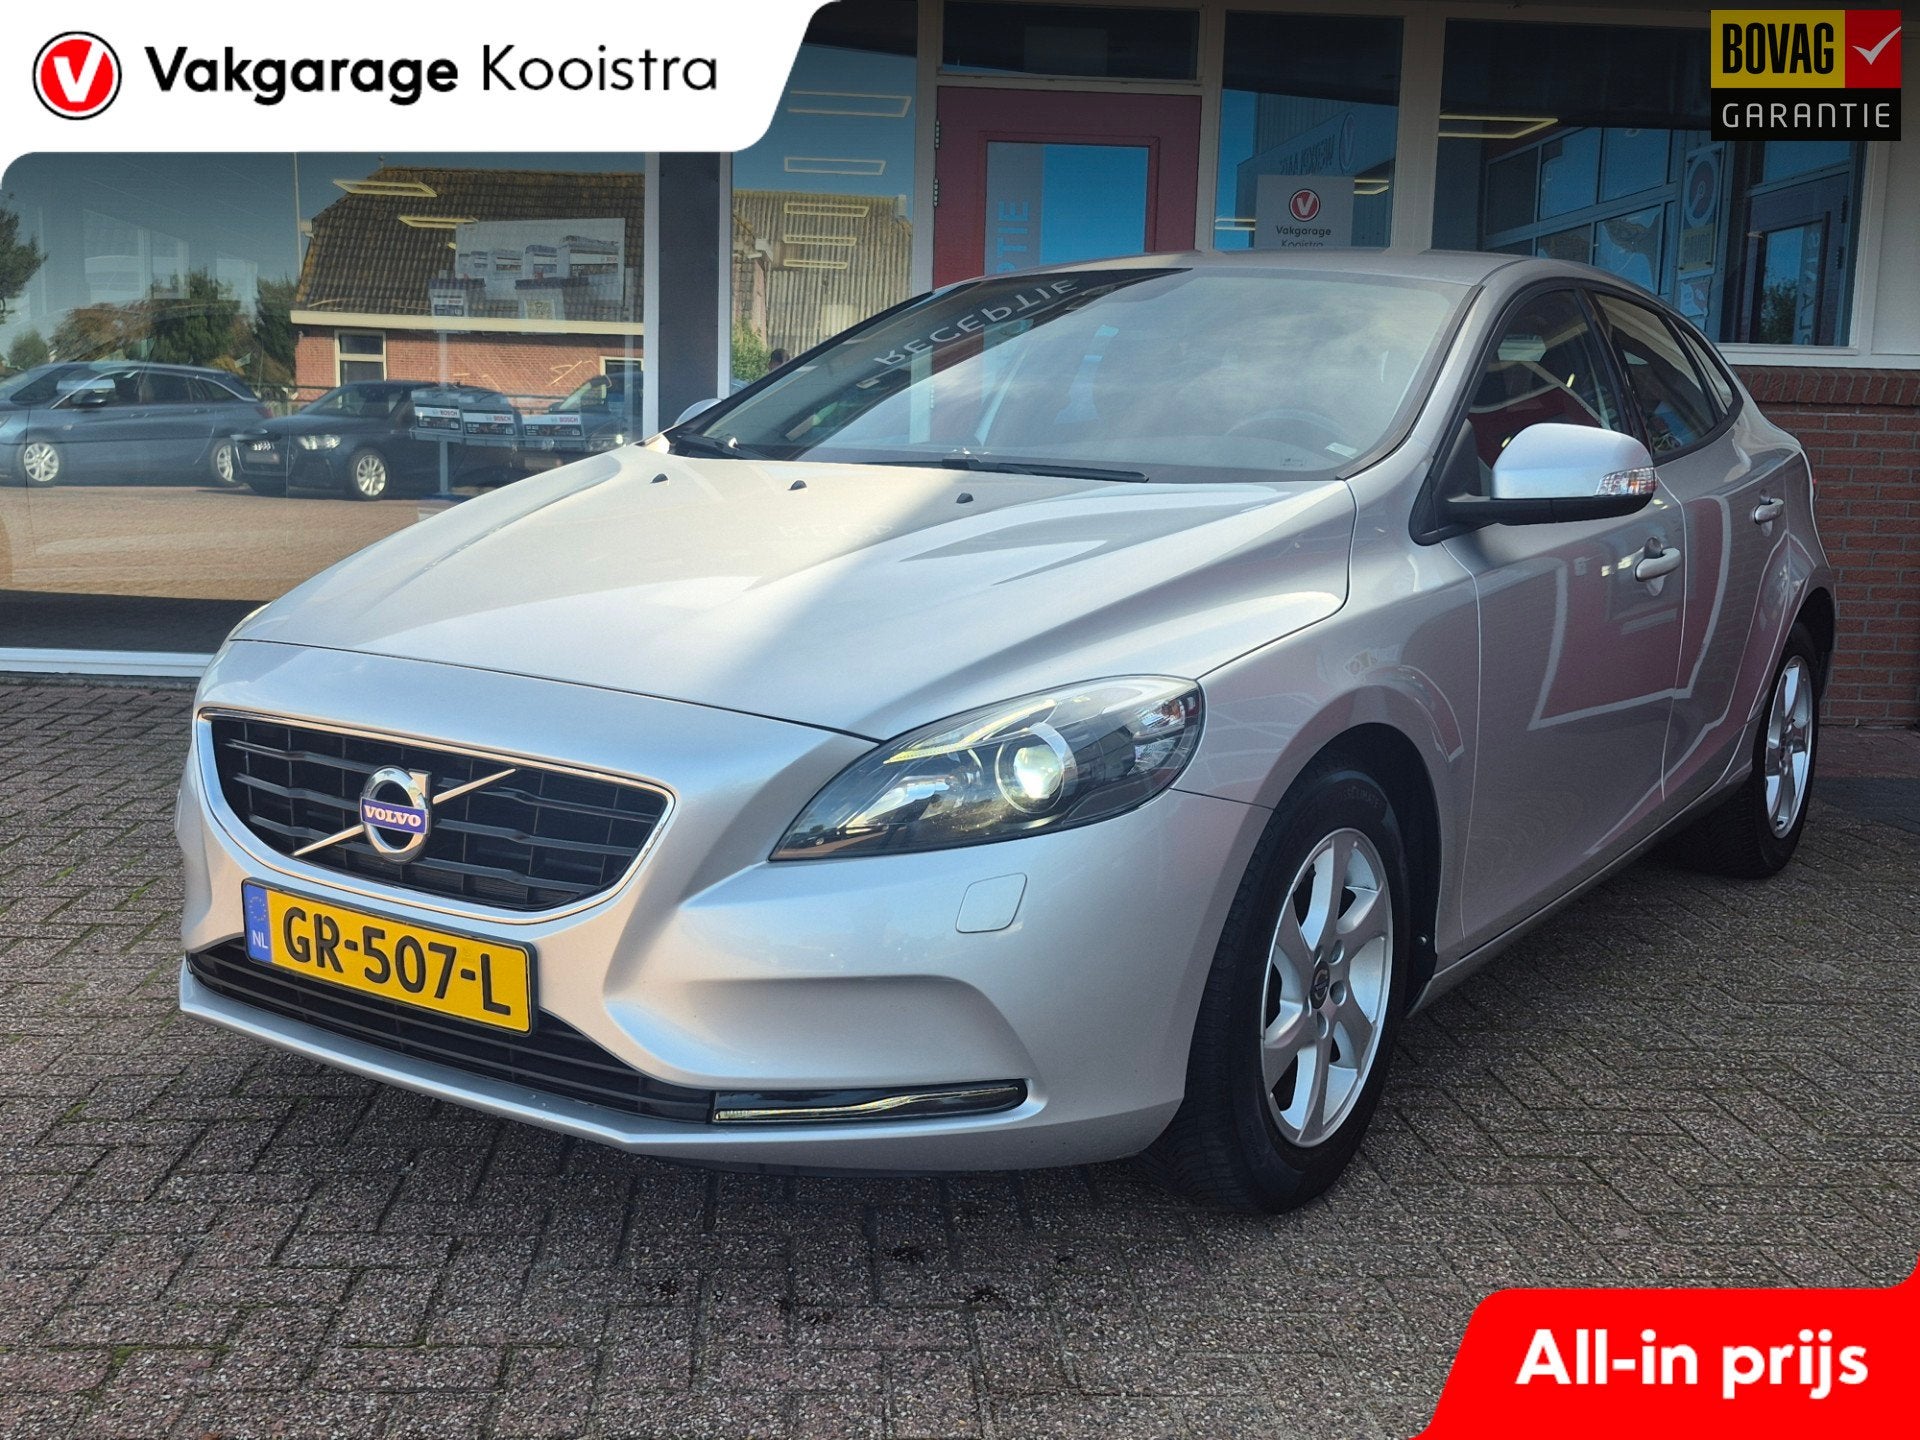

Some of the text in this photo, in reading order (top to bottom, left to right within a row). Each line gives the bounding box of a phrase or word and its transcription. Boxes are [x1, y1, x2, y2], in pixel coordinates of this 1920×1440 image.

[1276, 225, 1332, 238] Vakgarage
[440, 408, 458, 417] BOSCH
[493, 415, 512, 423] BOSCH
[363, 805, 422, 828] VOLVO
[252, 929, 269, 949] NL
[283, 906, 511, 1016] GR-507-L
